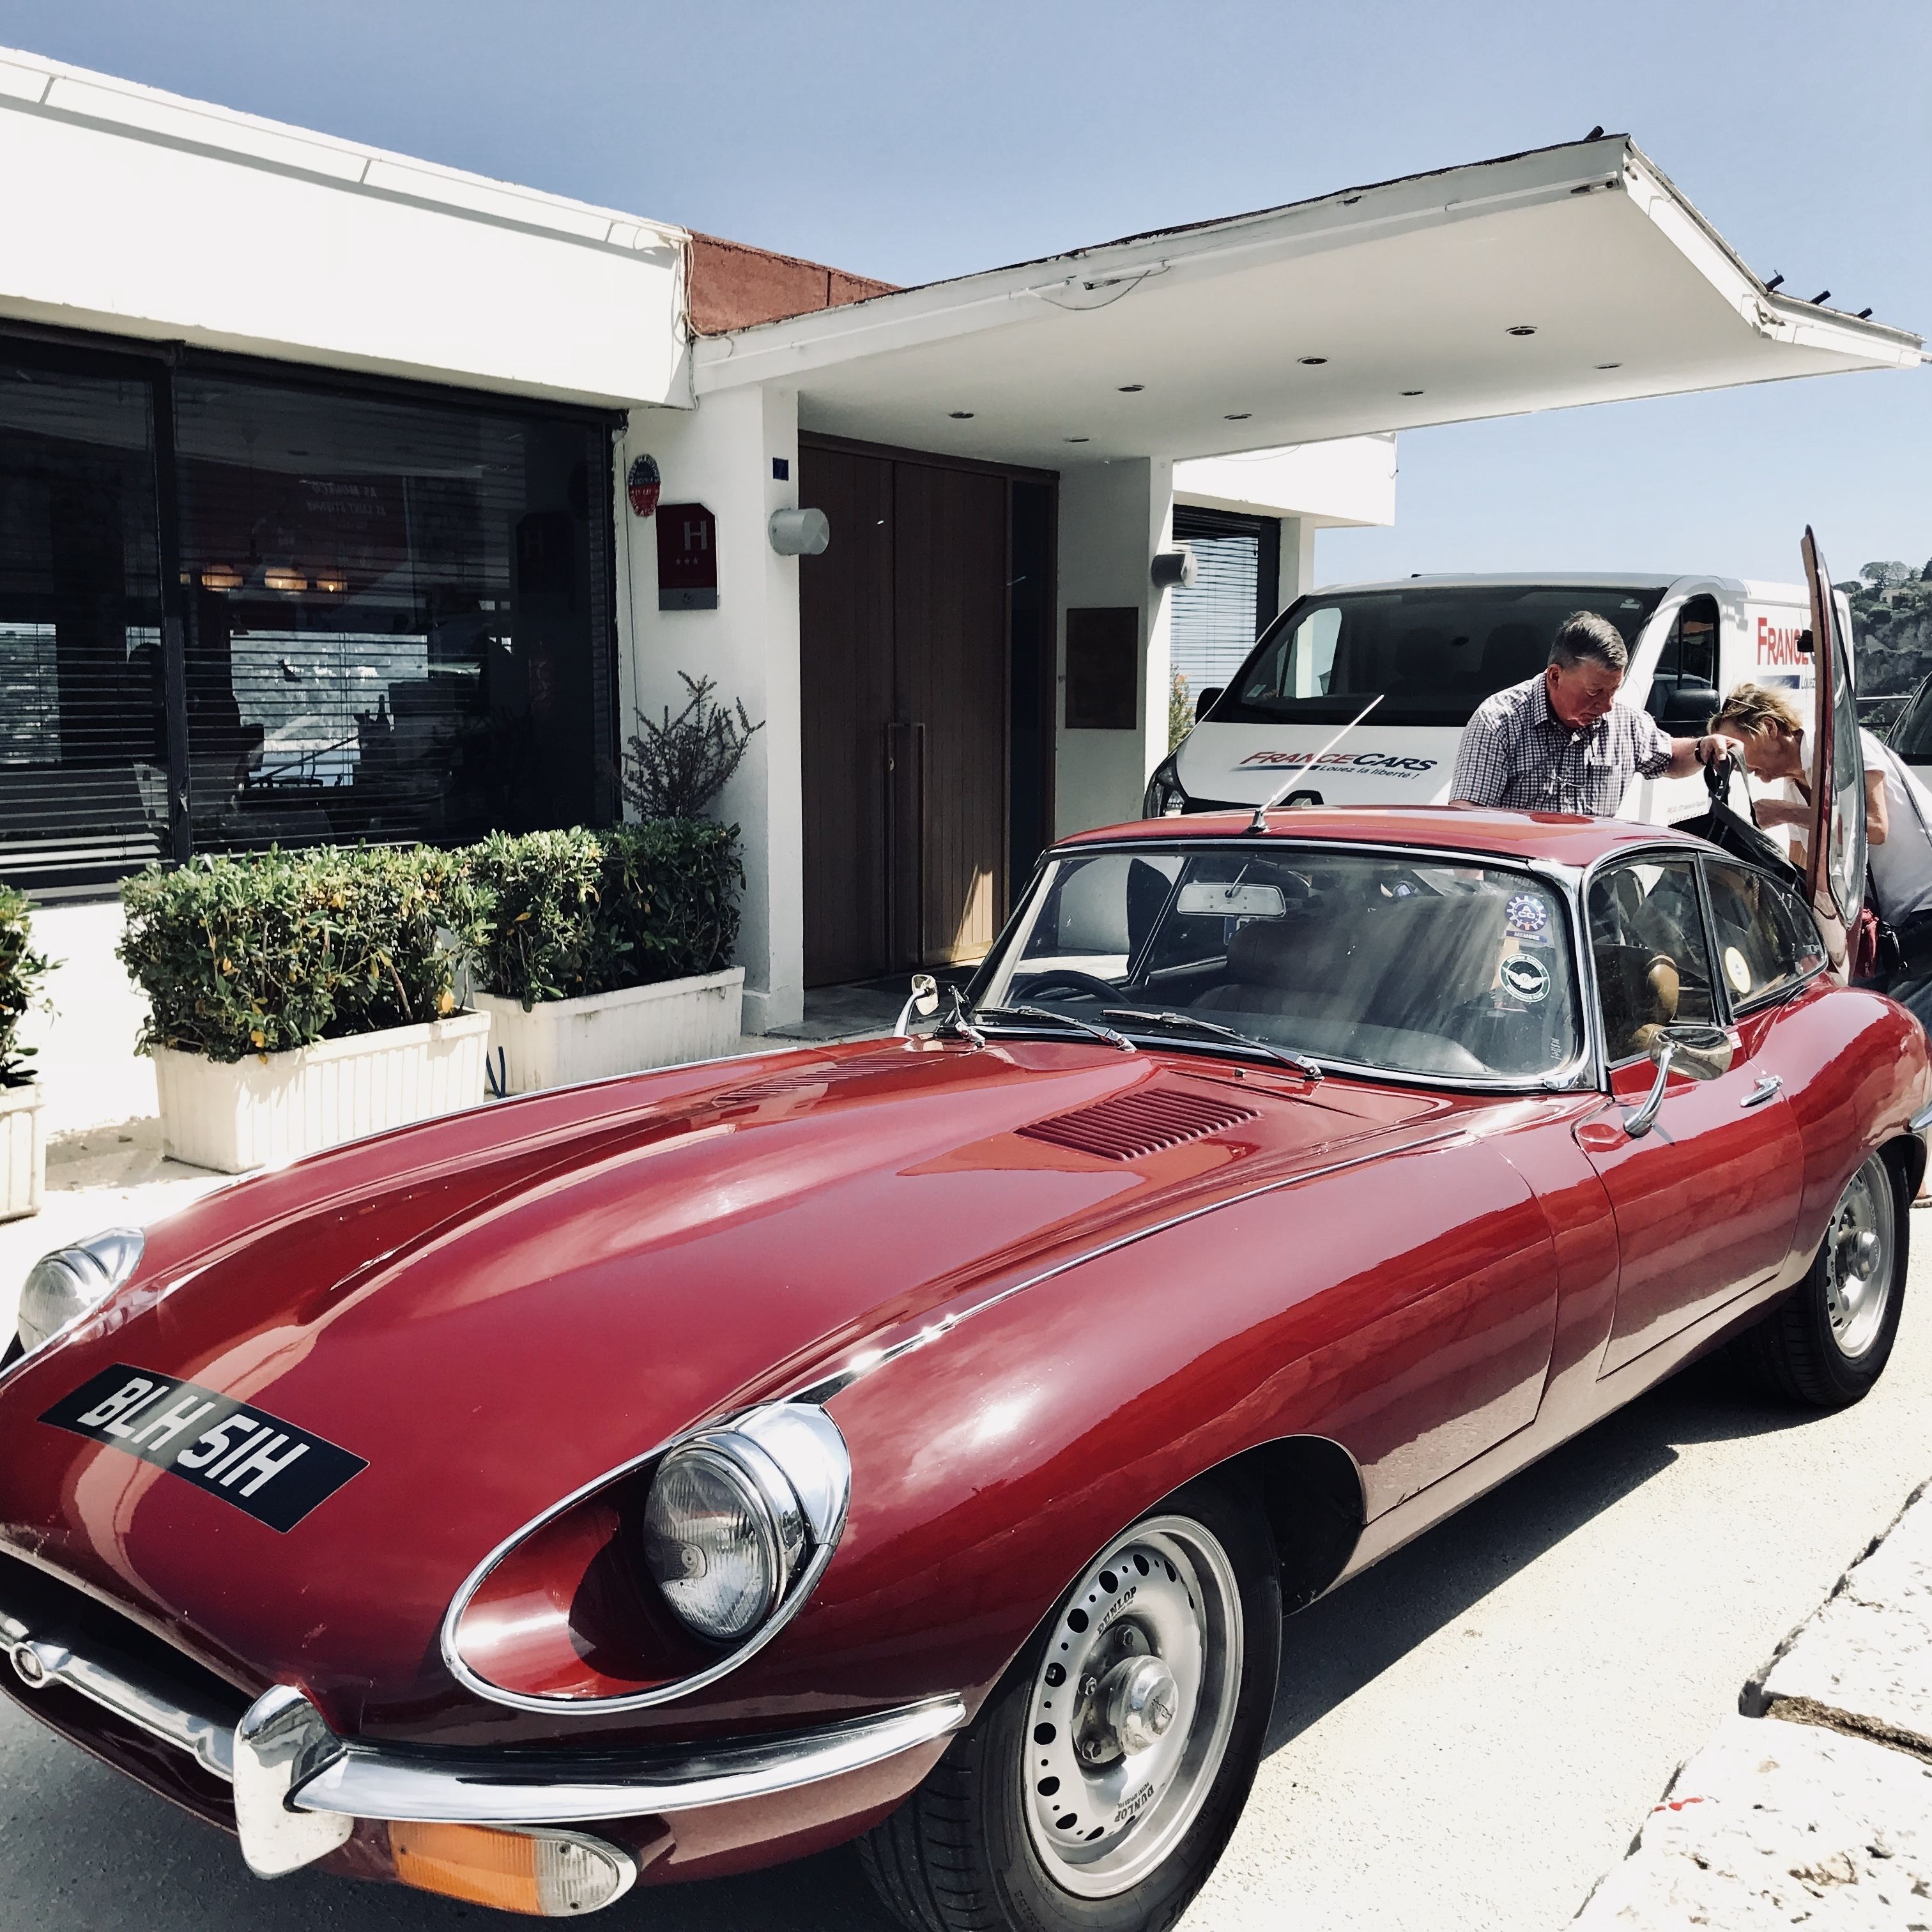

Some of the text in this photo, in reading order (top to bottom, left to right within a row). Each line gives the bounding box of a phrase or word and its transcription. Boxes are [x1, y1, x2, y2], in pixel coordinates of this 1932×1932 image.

[684, 521, 707, 550] H
[1514, 931, 1540, 941] MEMBRE
[77, 1377, 310, 1497] BLH 51H
[1096, 1586, 1137, 1635] DUNLOP
[1114, 1784, 1154, 1822] DUNLOP
